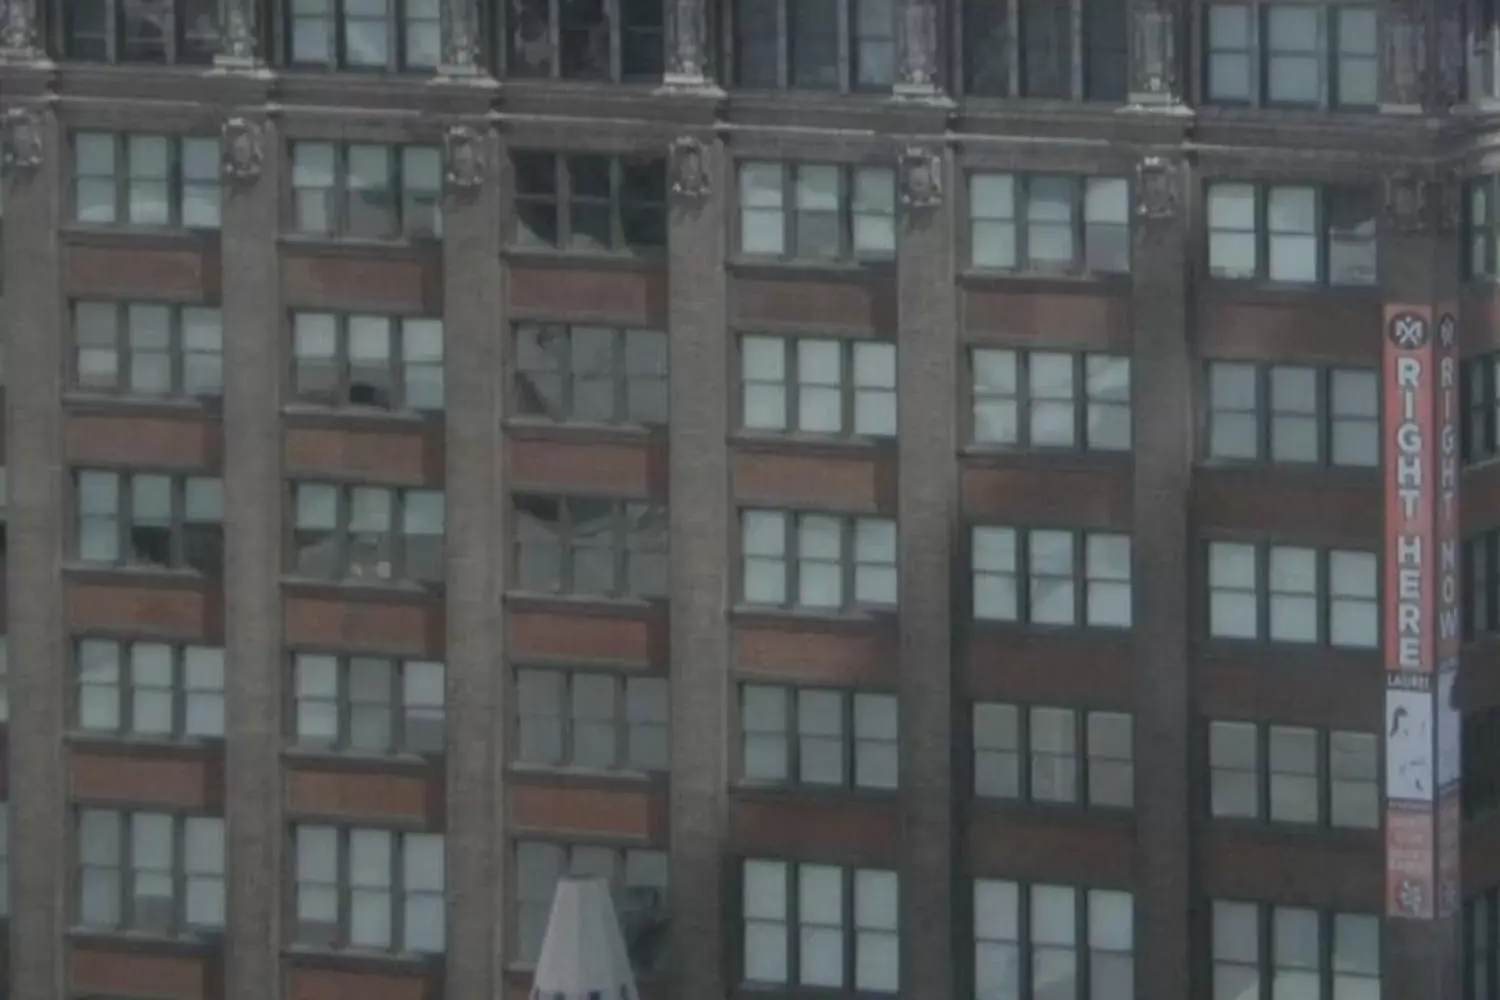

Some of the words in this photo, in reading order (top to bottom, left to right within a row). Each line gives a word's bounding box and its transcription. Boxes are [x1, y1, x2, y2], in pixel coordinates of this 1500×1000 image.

[1397, 356, 1421, 518] RIGHT
[1440, 356, 1455, 521] RIGHT
[1397, 534, 1421, 667] HERE
[1440, 539, 1458, 641] NOW
